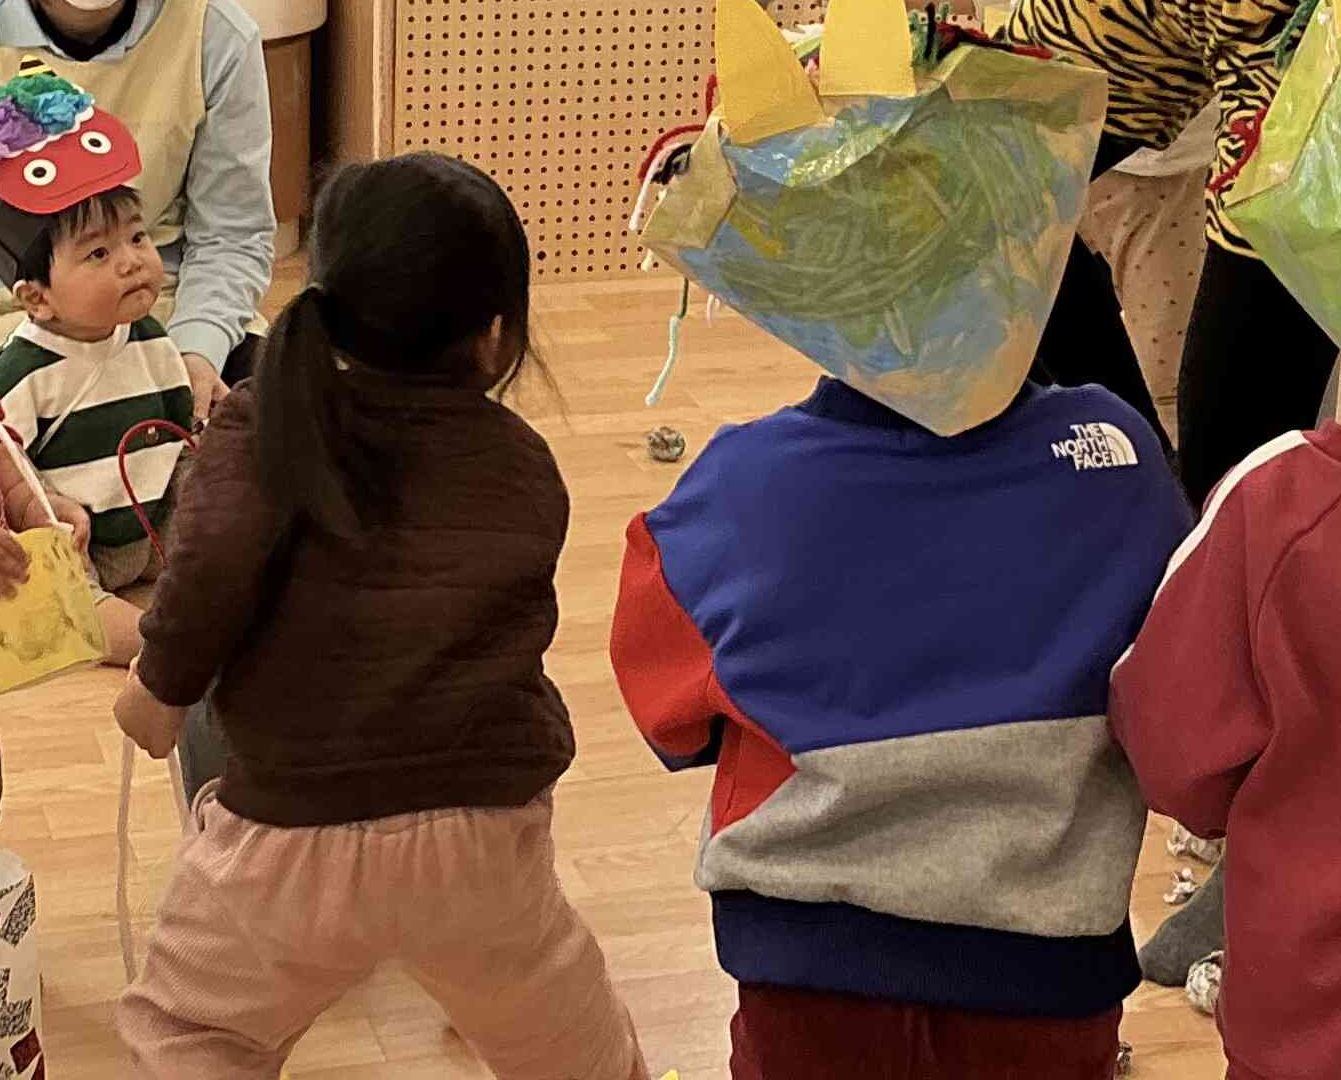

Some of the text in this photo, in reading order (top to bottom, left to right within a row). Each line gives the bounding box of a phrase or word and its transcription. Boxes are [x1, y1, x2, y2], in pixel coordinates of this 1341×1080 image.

[1069, 422, 1104, 440] THE
[1050, 436, 1109, 459] NORTH
[1072, 451, 1113, 471] FACE
